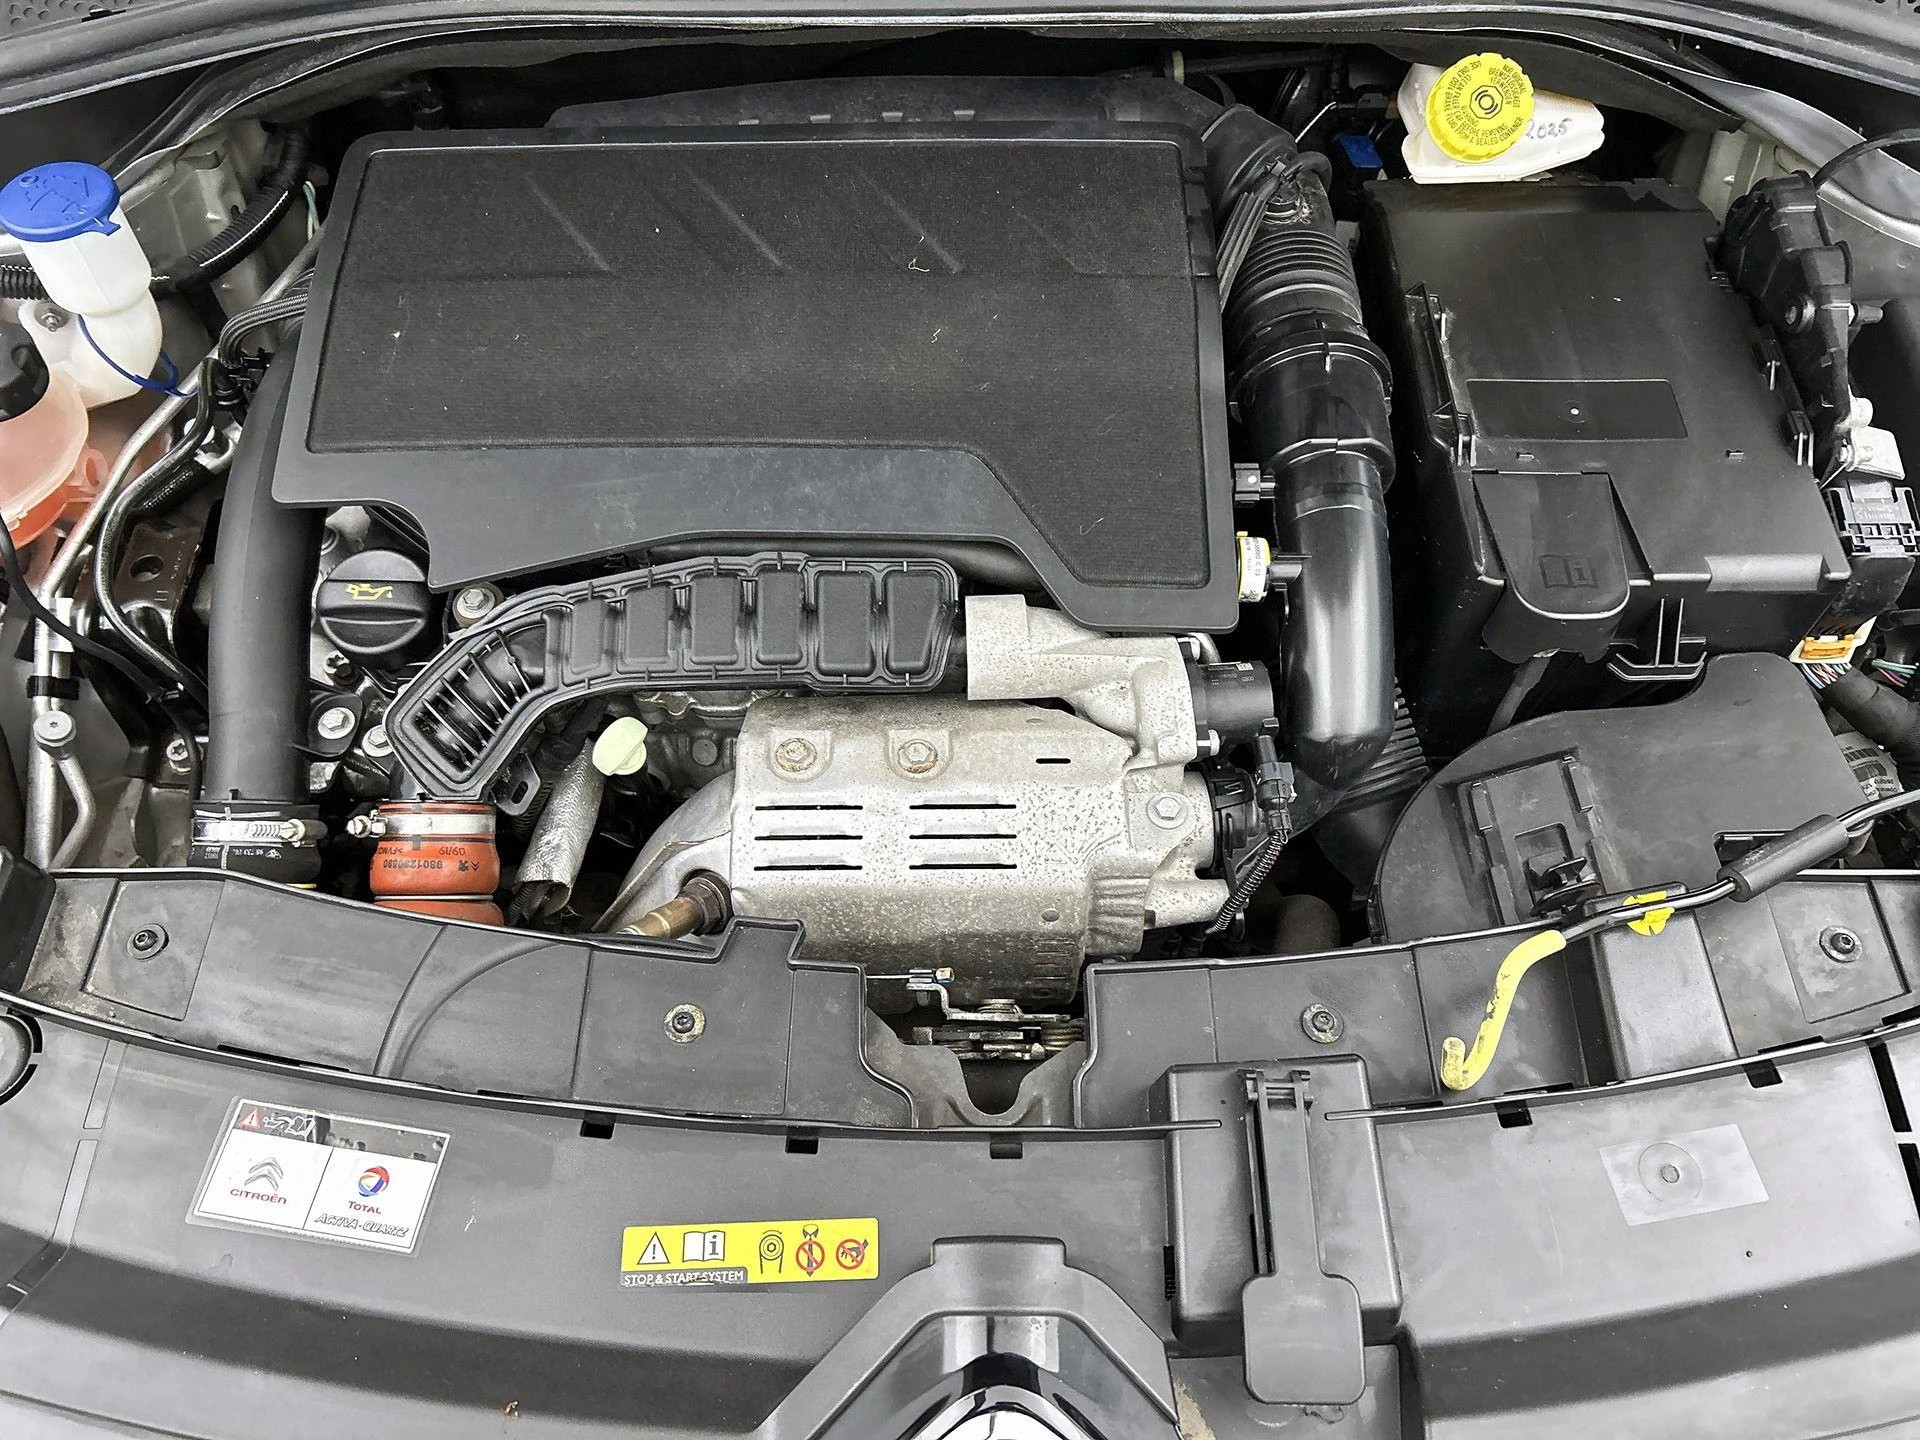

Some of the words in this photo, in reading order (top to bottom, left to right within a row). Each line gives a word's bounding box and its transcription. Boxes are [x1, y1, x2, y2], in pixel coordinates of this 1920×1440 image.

[1456, 74, 1472, 91] CLEAN
[1469, 60, 1482, 70] USE
[1476, 137, 1499, 146] SEALED
[1499, 116, 1524, 142] CONTAINER
[348, 1200, 382, 1215] TOTAL
[623, 1273, 654, 1286] STOP
[655, 1273, 664, 1285] &
[665, 1271, 700, 1284] START
[701, 1270, 744, 1282] SYSTEM
